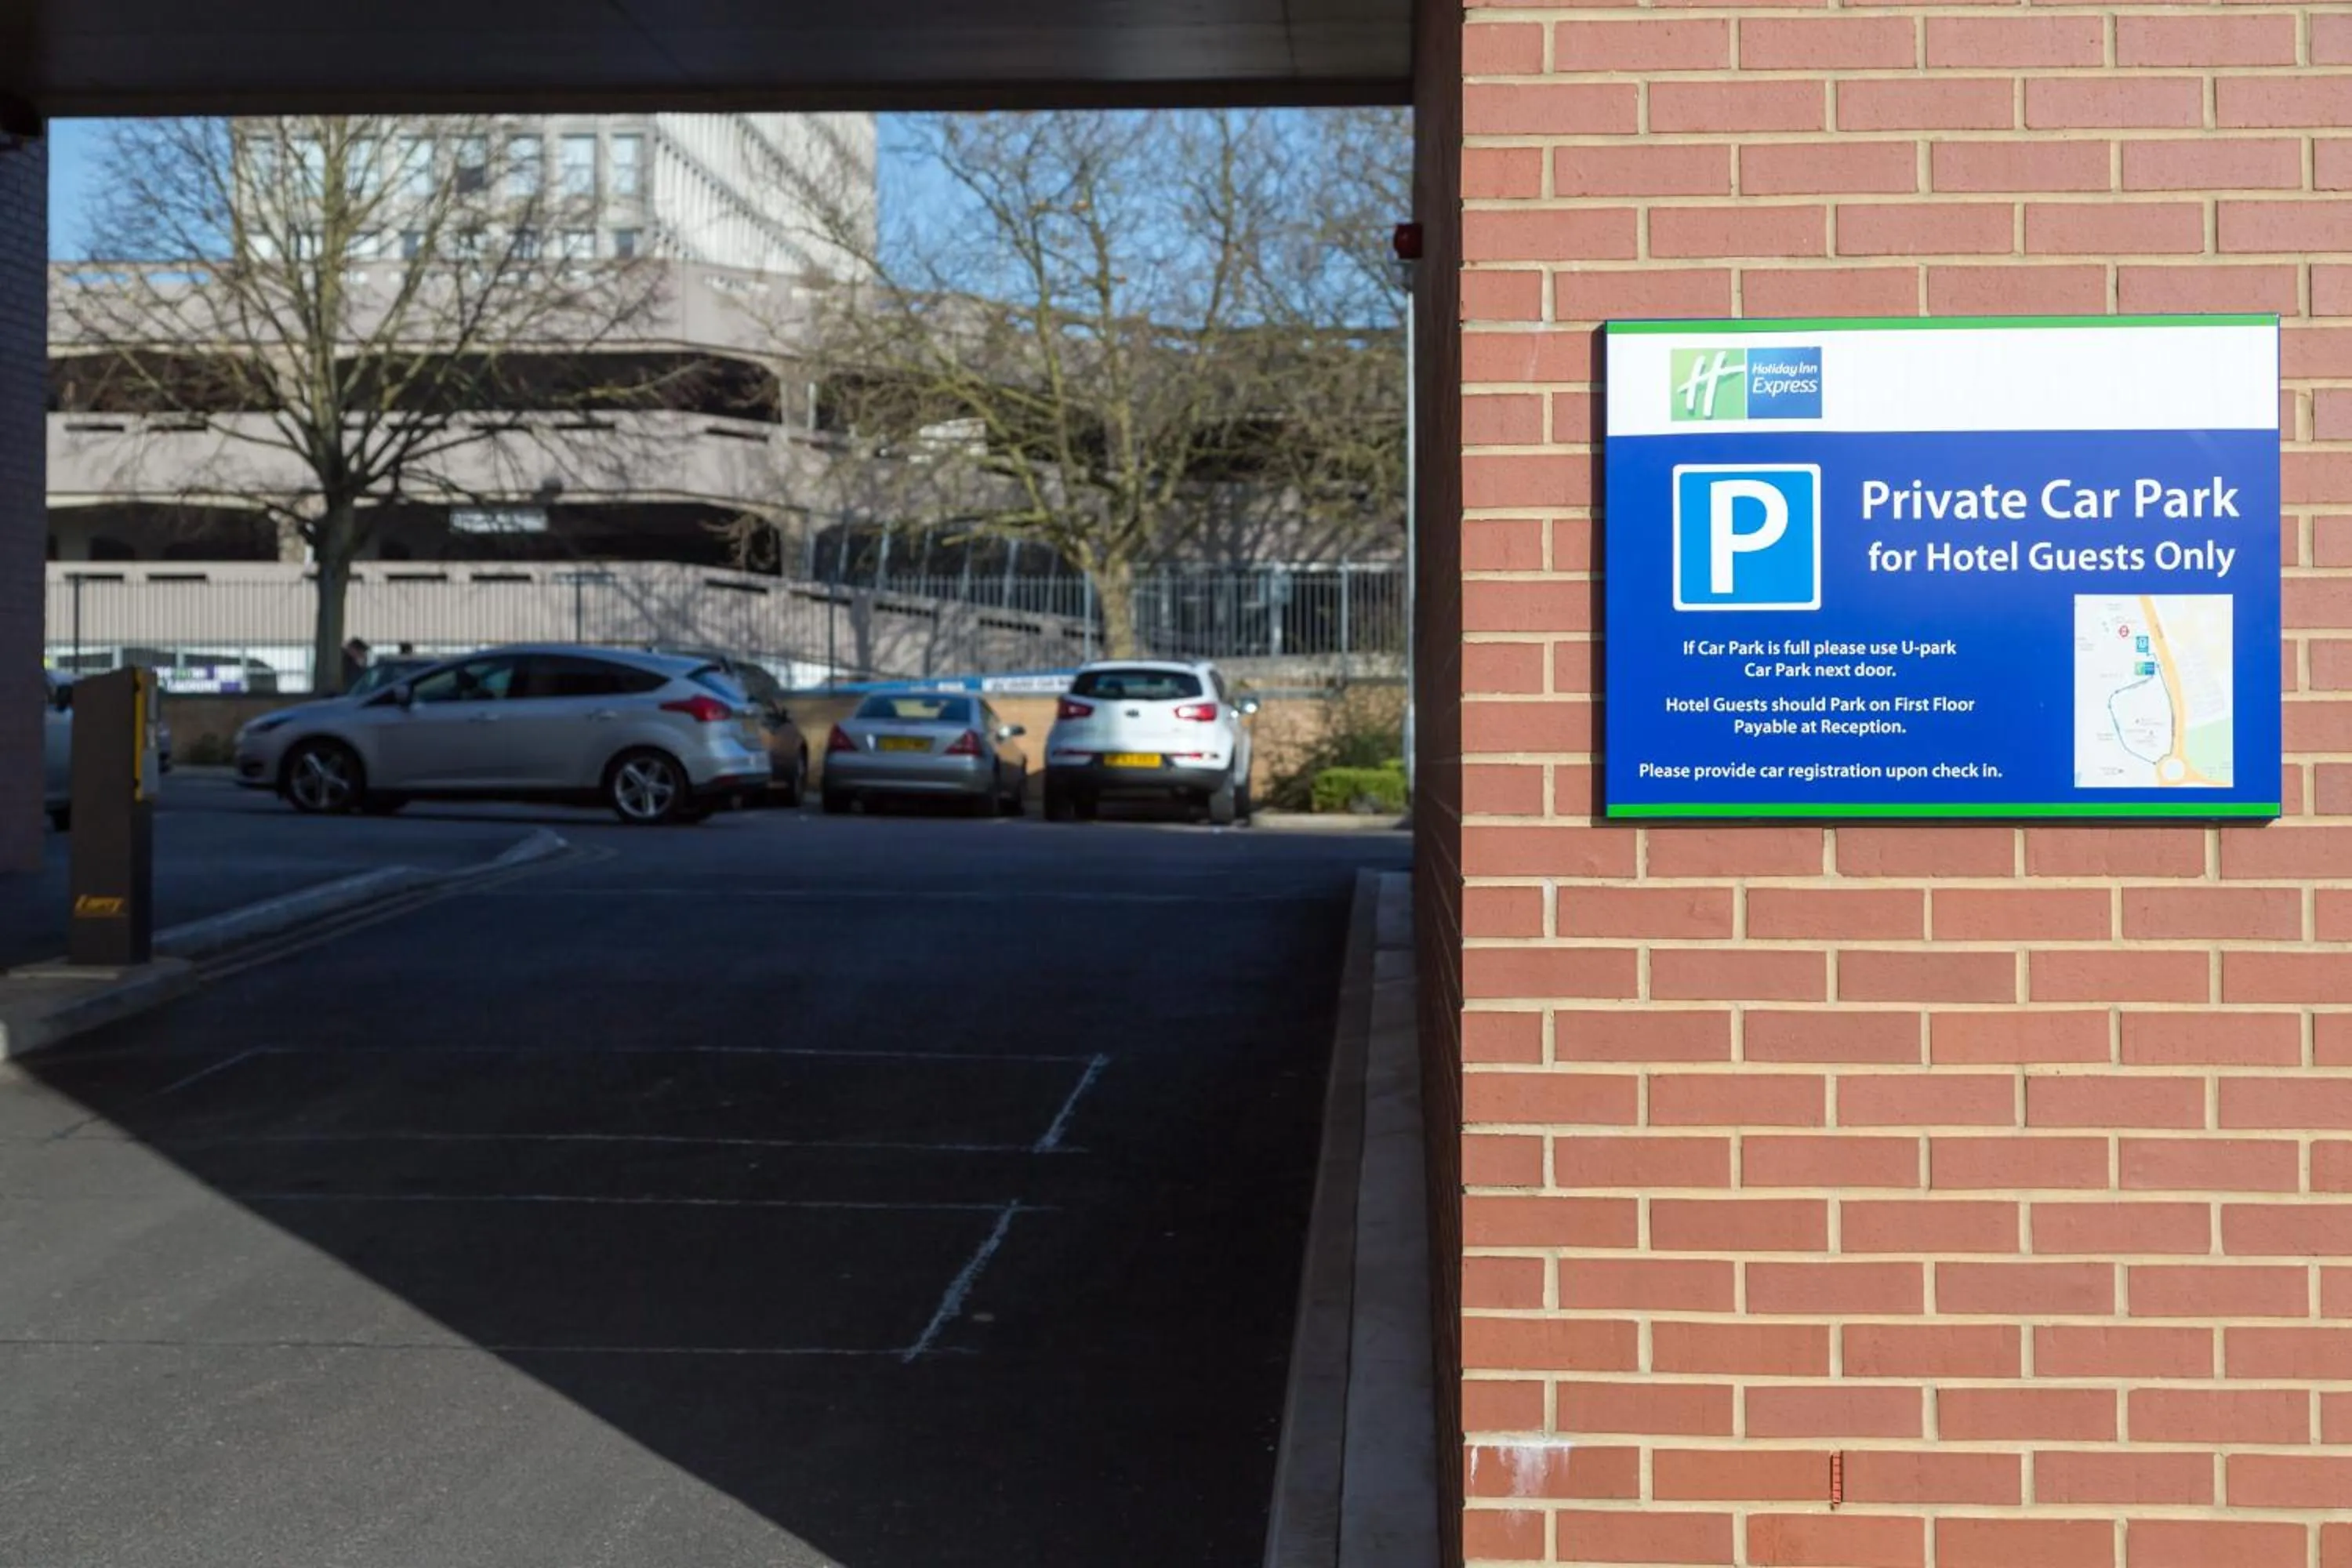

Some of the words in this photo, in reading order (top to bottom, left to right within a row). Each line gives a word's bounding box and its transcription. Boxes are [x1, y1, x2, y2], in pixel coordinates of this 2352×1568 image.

[1751, 362, 1798, 377] Holiday
[1799, 361, 1818, 374] Inn
[1752, 376, 1818, 397] Express
[1863, 479, 2028, 520] Private
[2041, 478, 2121, 520] Car
[2135, 476, 2241, 518] Park
[1710, 479, 1788, 593] P
[1867, 541, 1918, 572] for
[1927, 540, 2018, 572] Hotel
[2028, 541, 2146, 572] Guests
[2154, 539, 2236, 578] Only
[1683, 640, 1696, 655] If
[1698, 640, 1726, 655] Car
[1729, 640, 1765, 655] Park
[1768, 641, 1780, 655] is
[1784, 640, 1810, 655] full
[1813, 640, 1866, 658] please
[1870, 644, 1898, 655] use
[1901, 640, 1957, 658] U-park
[1744, 662, 1772, 677] Car
[1775, 662, 1811, 677] Park
[1815, 664, 1851, 677] next
[1854, 662, 1896, 677] door.
[1666, 697, 1709, 712] Hotel
[1713, 697, 1768, 712] Guests
[1771, 697, 1826, 712] should
[1831, 696, 1866, 711] Park
[1869, 700, 1890, 712] on
[1895, 697, 1929, 711] First
[1933, 697, 1975, 711] Floor
[1734, 719, 1798, 737] Payable
[1801, 720, 1817, 734] at
[1821, 719, 1906, 737] Reception.
[1639, 763, 1690, 779] Please
[1694, 762, 1756, 781] provide
[1760, 766, 1784, 778] car
[1788, 763, 1882, 782] registration
[1886, 766, 1928, 781] upon
[1932, 763, 1979, 778] check
[1983, 763, 2002, 777] in.
